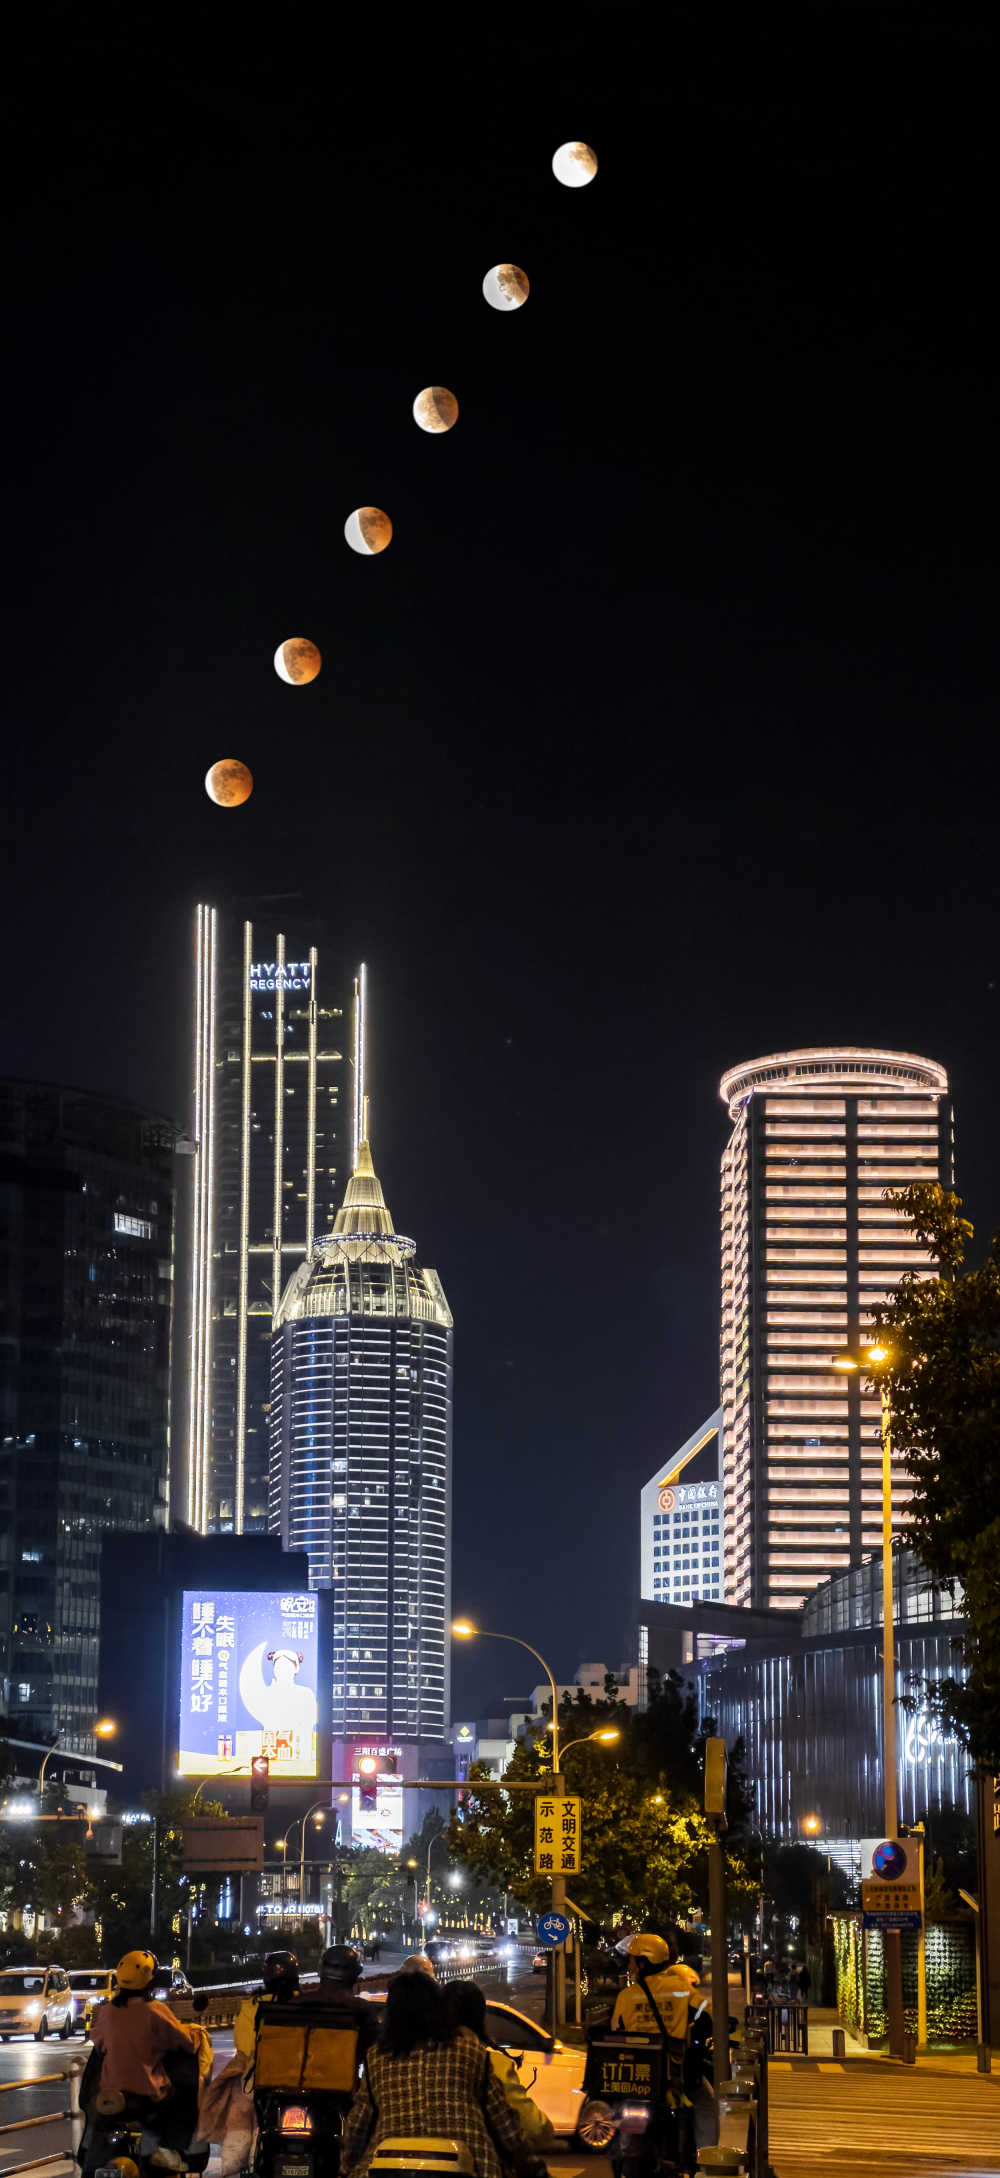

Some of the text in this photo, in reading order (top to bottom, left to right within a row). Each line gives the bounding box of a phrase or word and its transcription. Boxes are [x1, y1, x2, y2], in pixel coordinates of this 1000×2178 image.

[250, 963, 311, 977] HYATT
[250, 978, 310, 990] REGENCY
[215, 1615, 235, 1648] 失眠
[190, 1602, 215, 1713] 睡不着 睡不好
[539, 1801, 554, 1869] 示范路
[561, 1801, 576, 1869] 文明交通
[601, 2062, 651, 2081] 订门票
